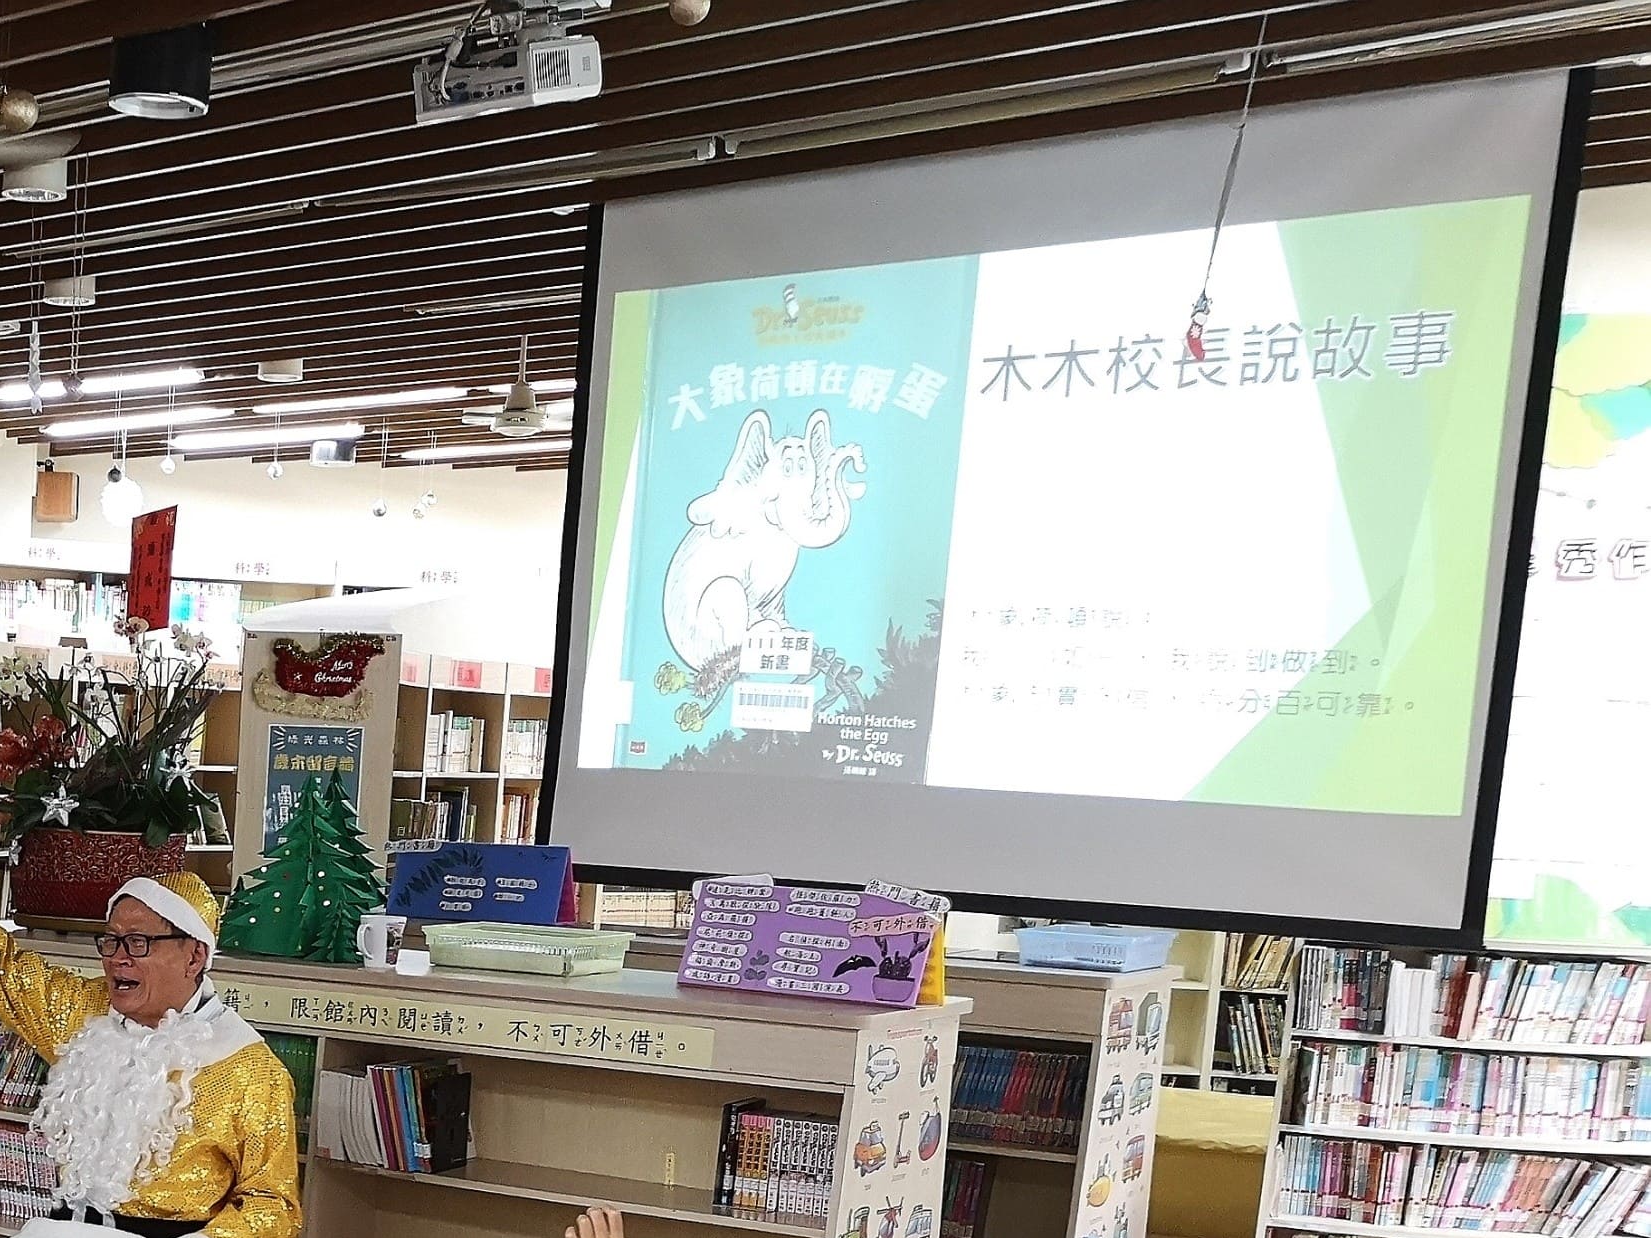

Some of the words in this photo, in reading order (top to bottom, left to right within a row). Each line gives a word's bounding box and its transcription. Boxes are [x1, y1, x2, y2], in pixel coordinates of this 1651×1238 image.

[980, 309, 1454, 402] 木木校長說故事
[668, 359, 950, 430] 大象荷頓在孵蛋
[1527, 537, 1651, 580] 秀作
[760, 654, 789, 670] 新書
[817, 712, 862, 727] Horton
[864, 714, 917, 730] Hatches
[840, 727, 862, 740] the
[864, 728, 889, 745] Egg
[836, 744, 860, 764] Dr.
[861, 743, 905, 768] Seuss
[869, 880, 948, 912] 熱門書籍
